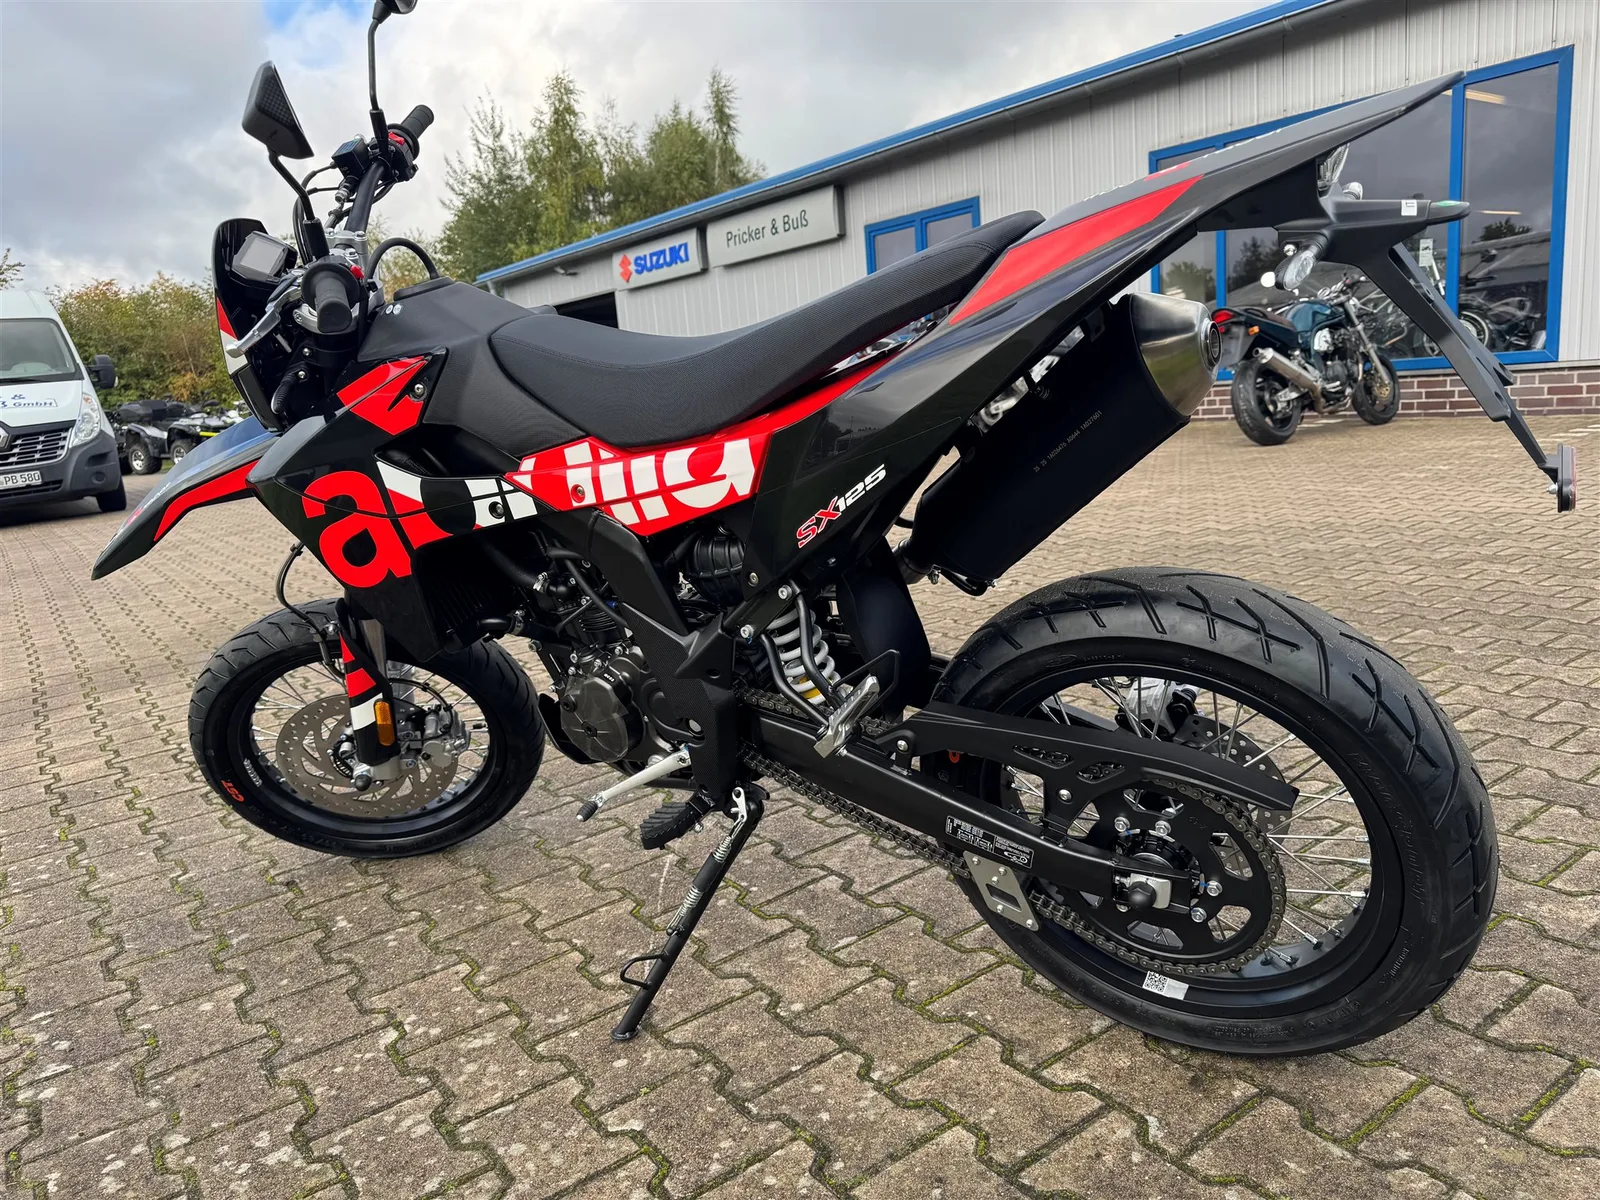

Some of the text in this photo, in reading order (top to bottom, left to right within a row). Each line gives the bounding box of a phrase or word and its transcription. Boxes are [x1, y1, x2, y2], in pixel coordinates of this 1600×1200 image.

[726, 209, 809, 248] Pricker & Buß
[633, 242, 690, 275] SUZUKI
[4, 471, 41, 485] PB 580
[796, 463, 887, 549] SX125
[221, 780, 244, 801] CST
